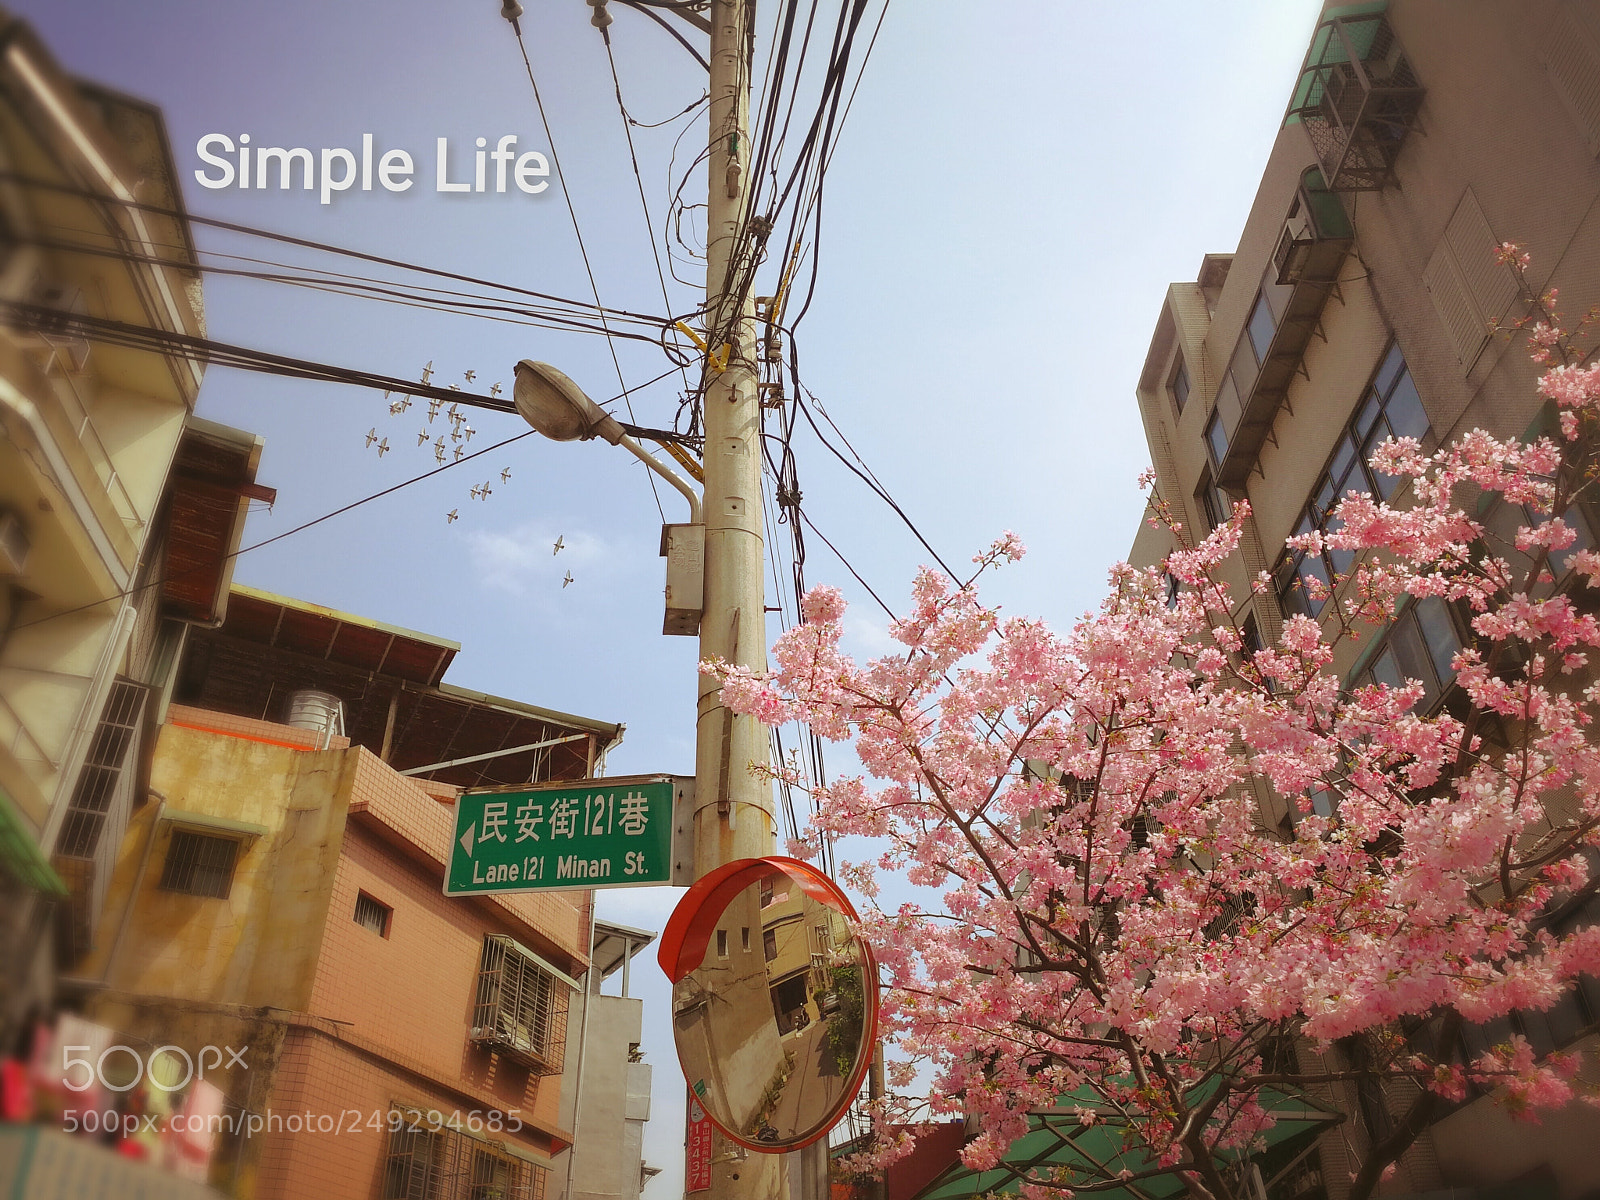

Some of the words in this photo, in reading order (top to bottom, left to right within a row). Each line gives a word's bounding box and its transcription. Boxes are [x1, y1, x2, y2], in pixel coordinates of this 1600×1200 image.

[477, 791, 649, 844] 民安街121巷
[556, 855, 611, 879] Minan
[623, 851, 649, 875] St.
[692, 1124, 701, 1184] 13437
